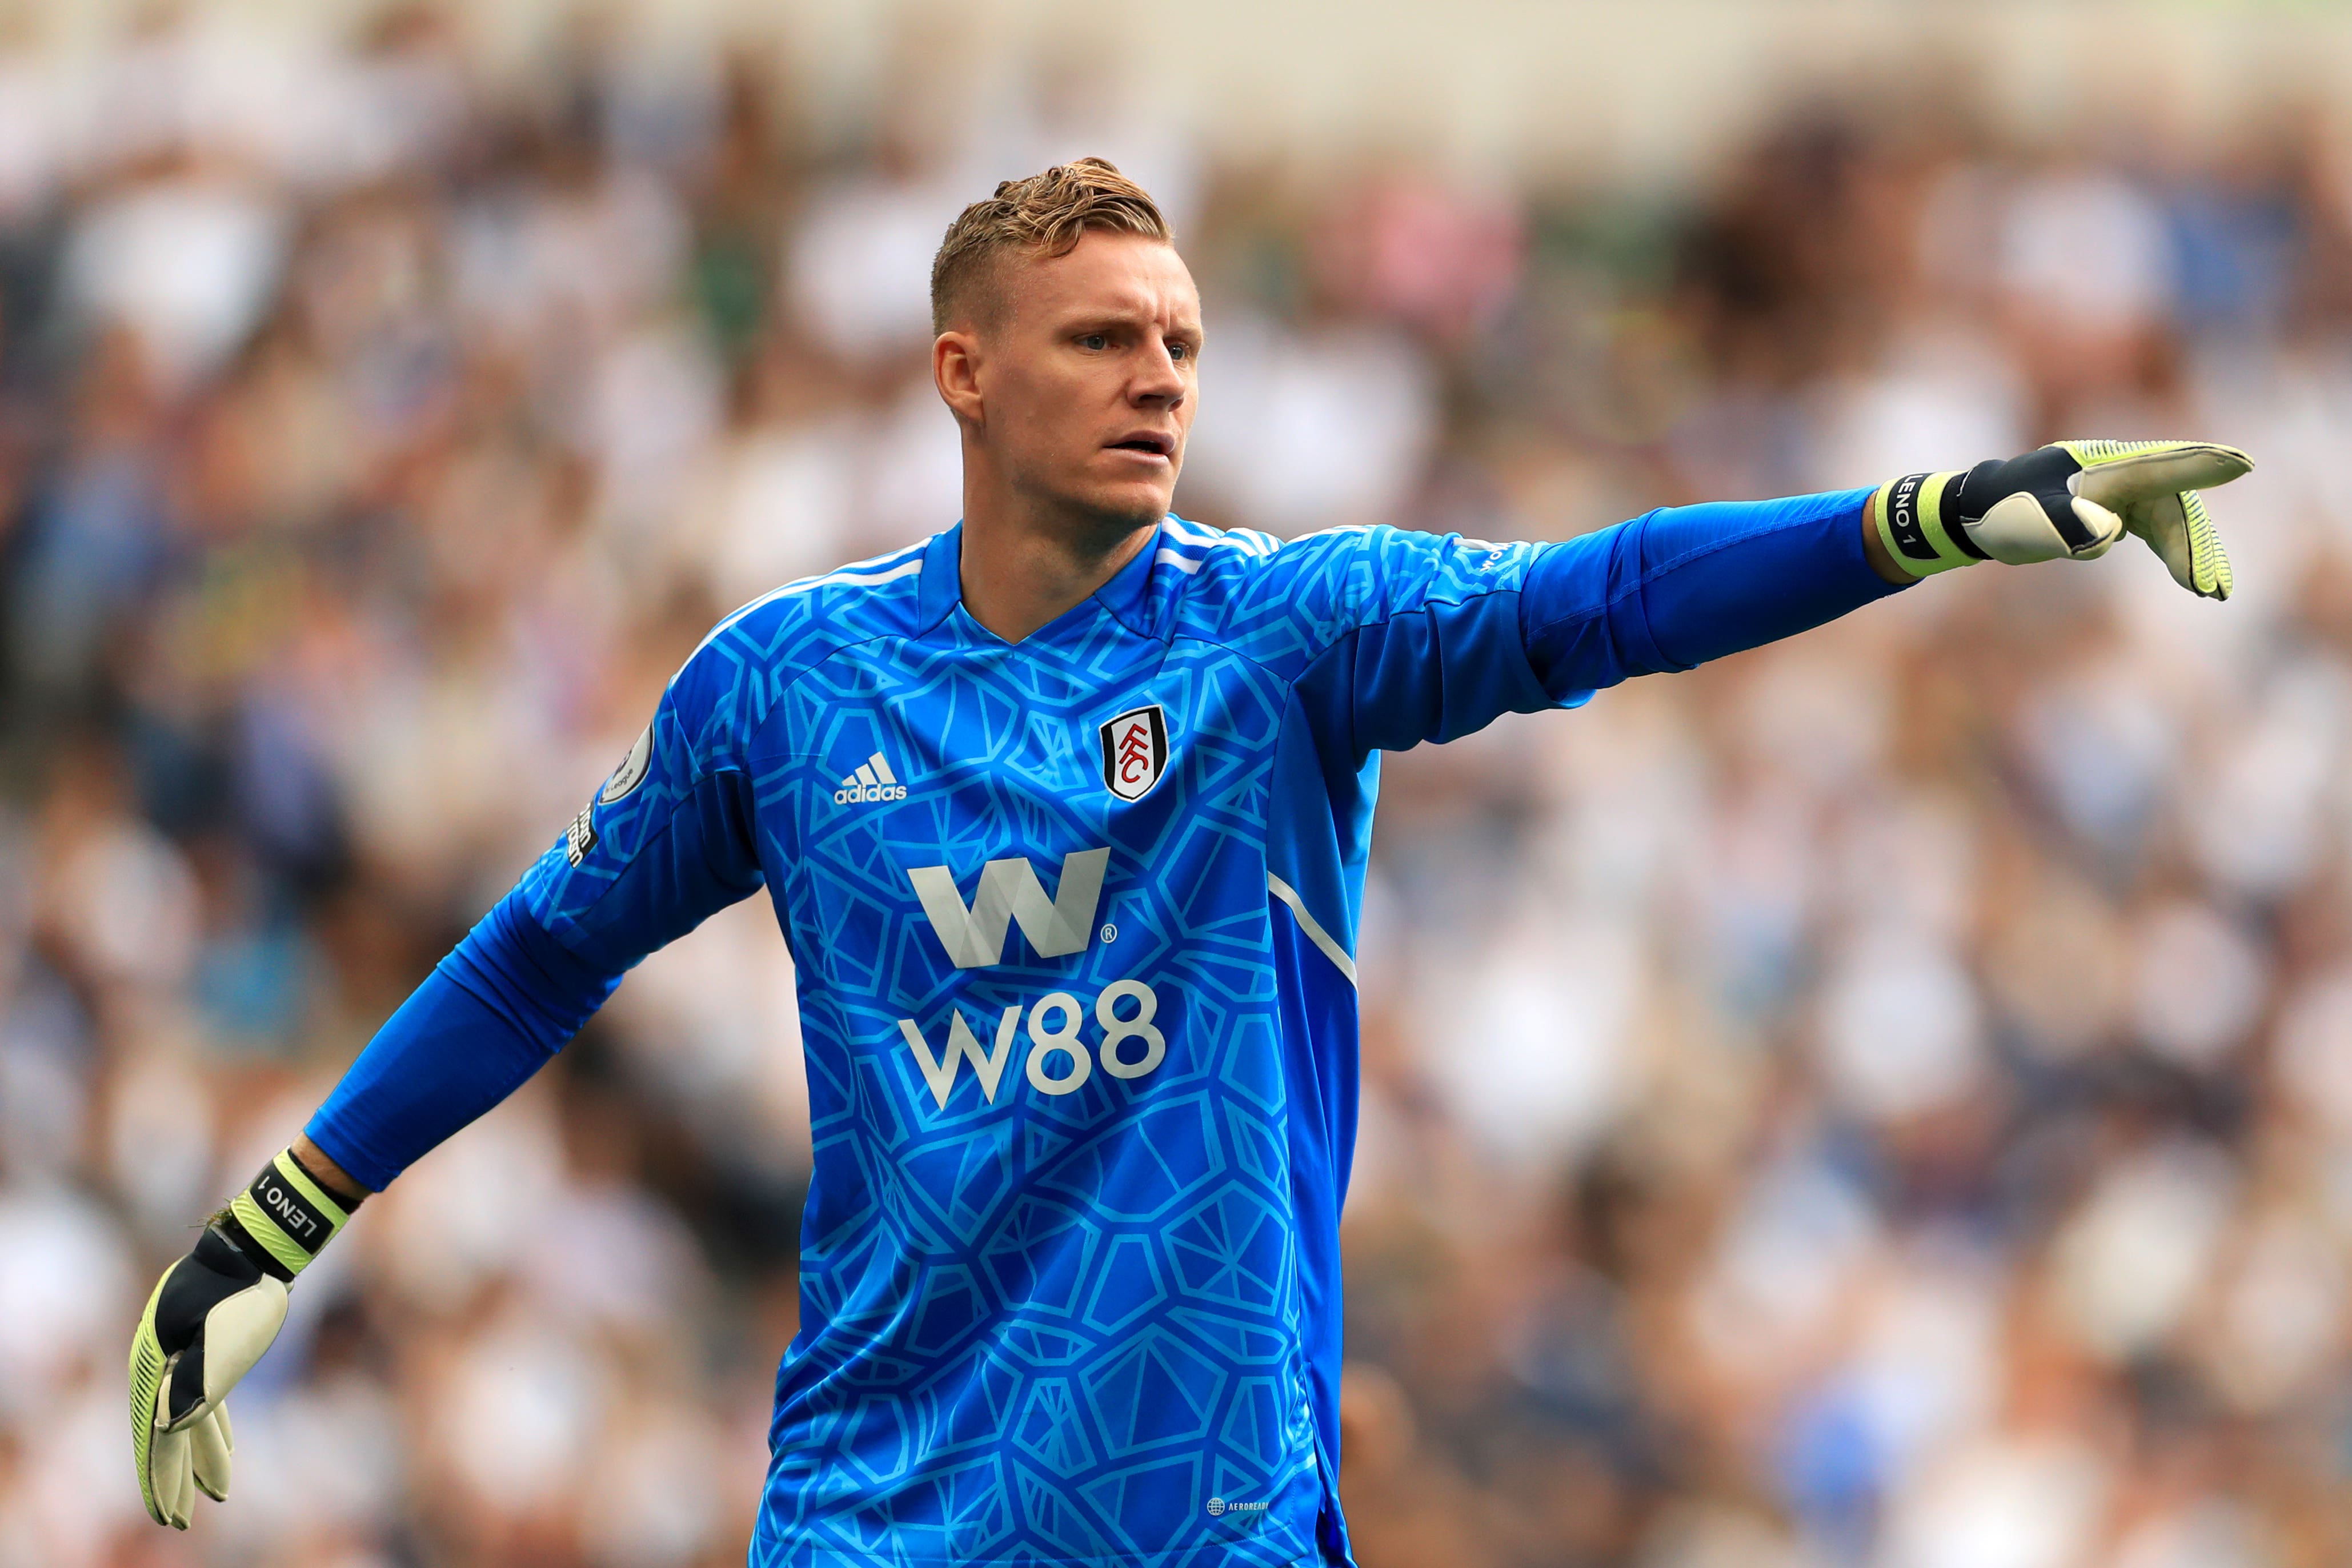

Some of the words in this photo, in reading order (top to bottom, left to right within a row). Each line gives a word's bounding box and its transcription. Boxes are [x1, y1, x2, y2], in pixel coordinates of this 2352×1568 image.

[1896, 474, 1924, 528] LENO
[1903, 534, 1917, 544] 1
[1119, 723, 1149, 783] FFC
[834, 783, 907, 805] adidas
[897, 979, 1166, 1112] W88
[258, 1176, 270, 1190] 1
[266, 1186, 318, 1237] LENO
[1228, 1501, 1269, 1511] AEROREADY
